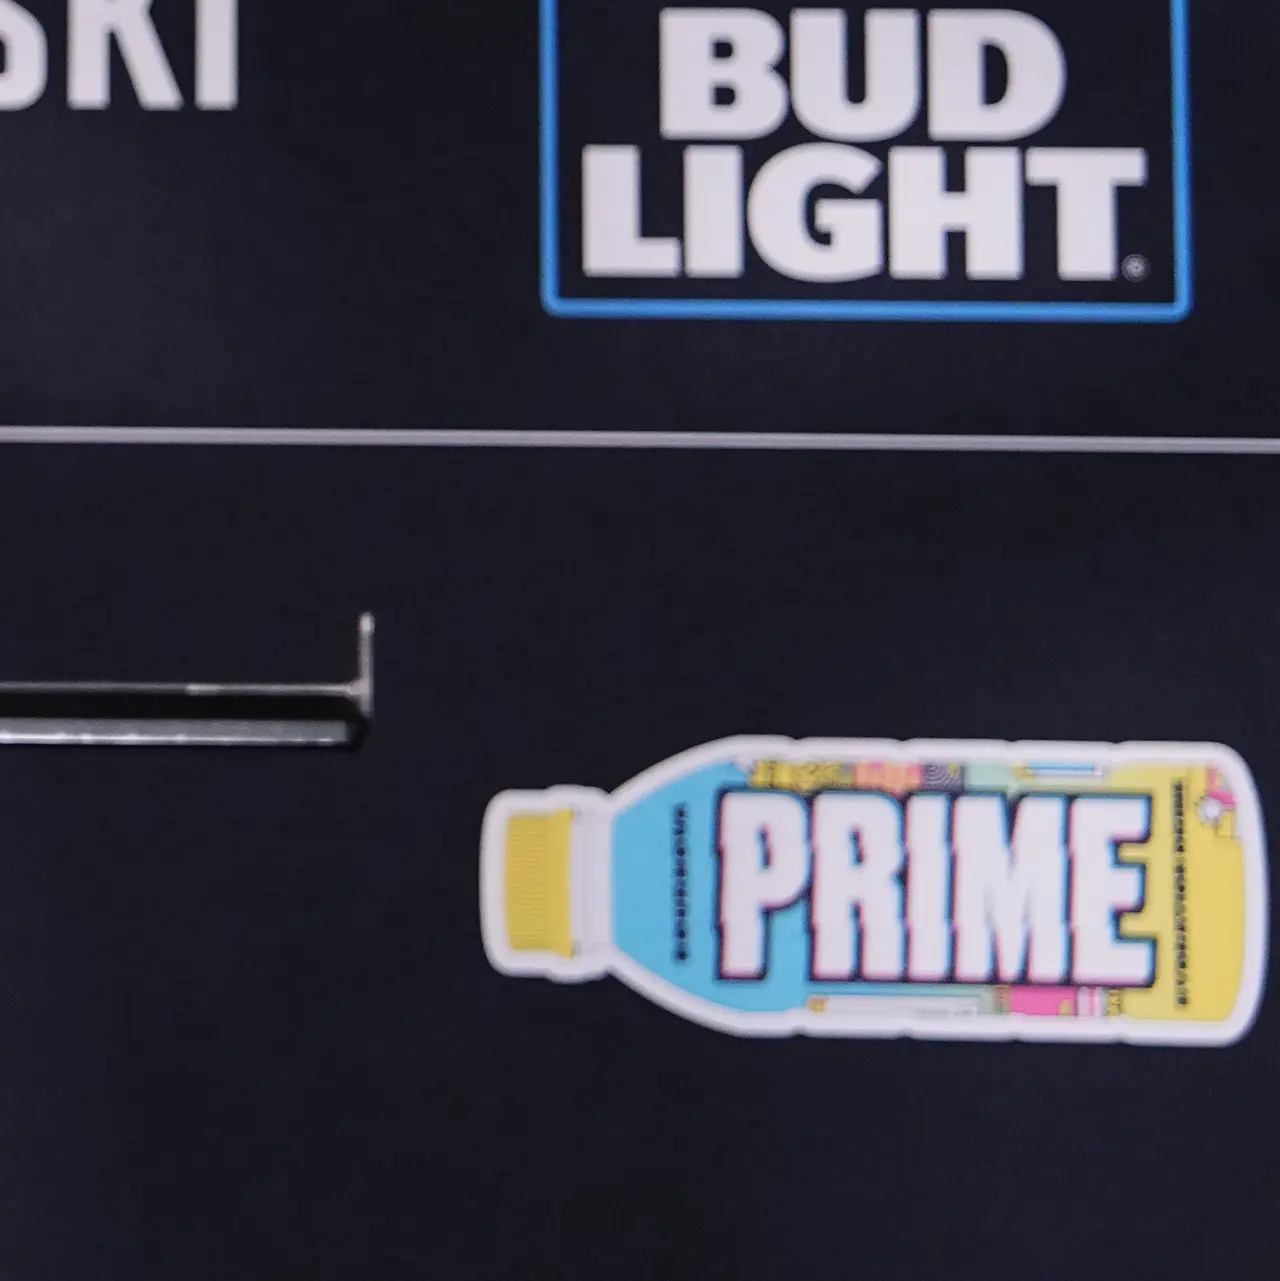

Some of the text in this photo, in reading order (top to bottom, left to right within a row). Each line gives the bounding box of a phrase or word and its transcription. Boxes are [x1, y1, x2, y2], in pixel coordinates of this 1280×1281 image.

[658, 6, 1067, 143] BUD
[582, 142, 1148, 284] LIGHT
[714, 785, 1157, 988] PRIME
